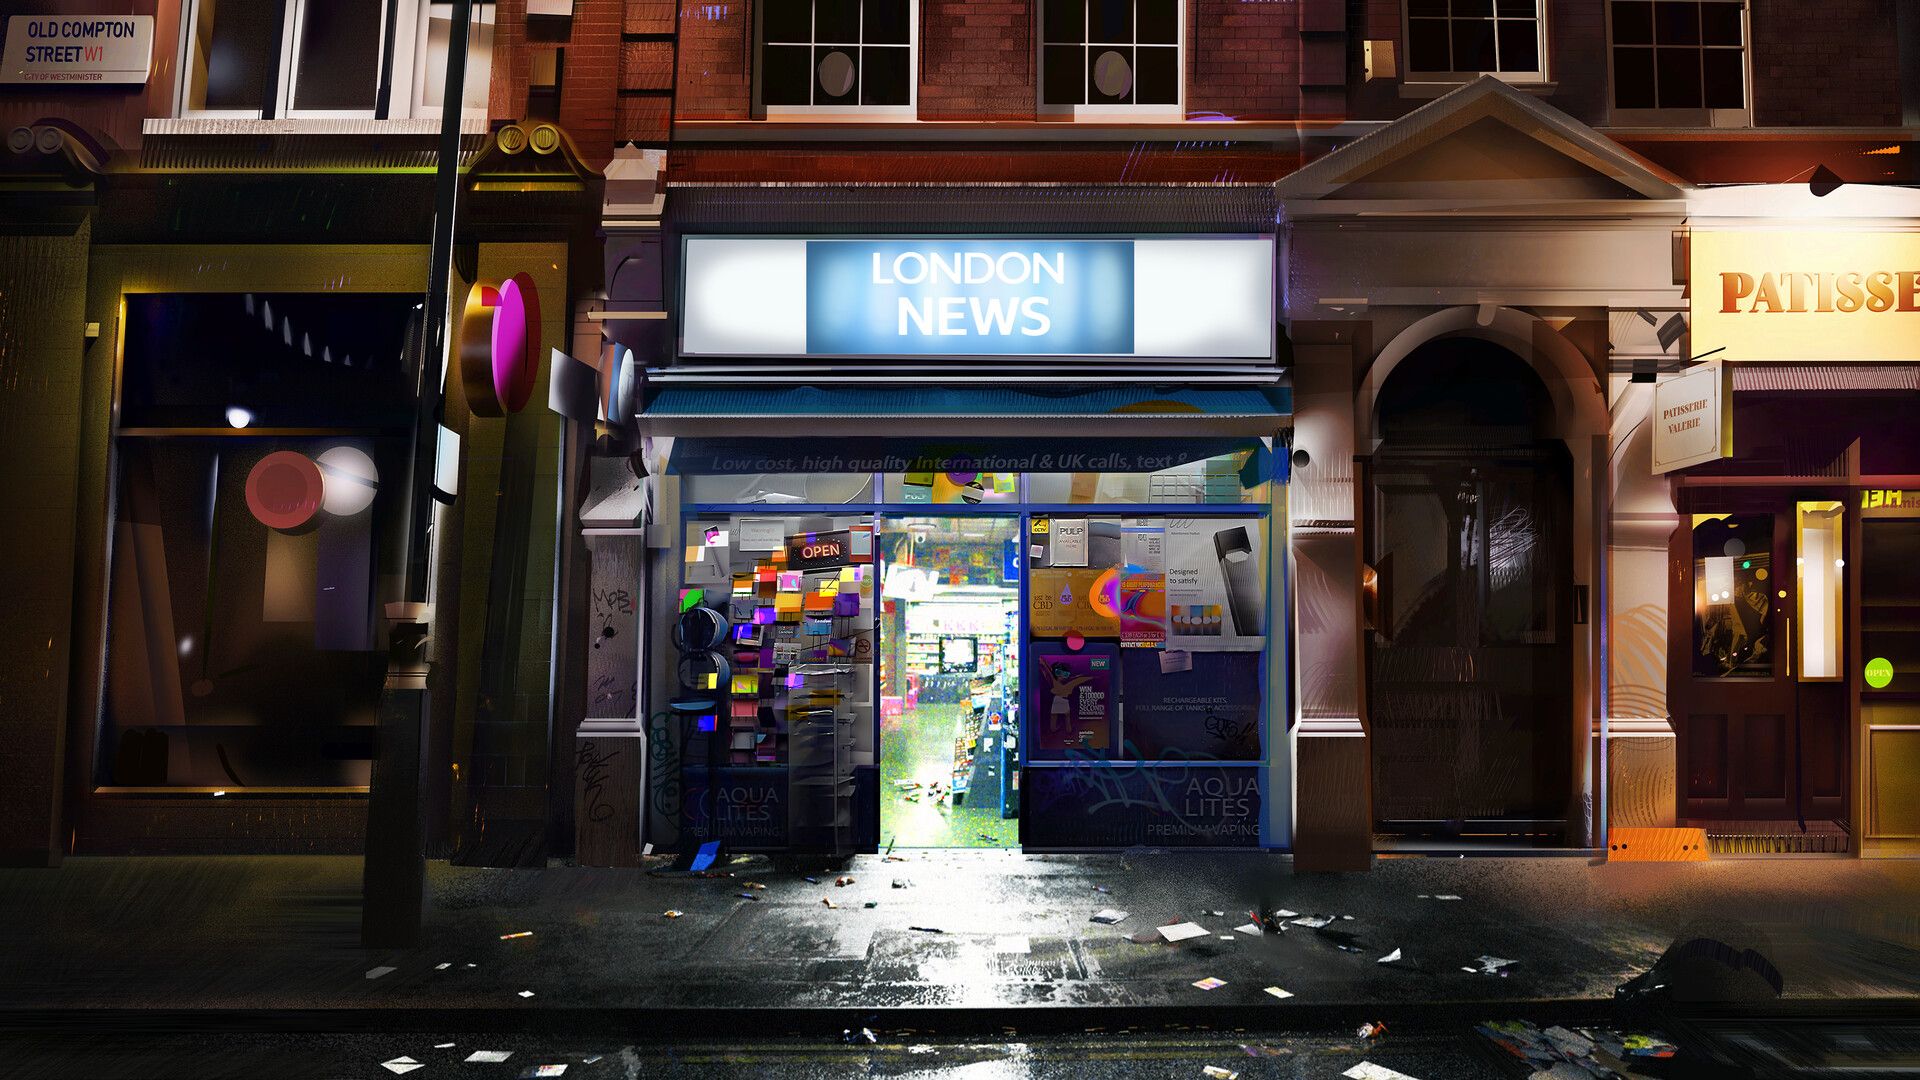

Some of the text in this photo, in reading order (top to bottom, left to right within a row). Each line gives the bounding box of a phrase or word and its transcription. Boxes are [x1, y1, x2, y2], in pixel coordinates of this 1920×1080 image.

[28, 21, 135, 38] OLD COMPTON
[25, 45, 103, 63] STREET W1
[40, 73, 49, 81] OF
[872, 252, 1065, 285] LONDON
[1719, 270, 1920, 313] PATISSE
[898, 296, 1051, 336] NEWS
[1663, 399, 1708, 420] PATISSERIE
[1668, 417, 1701, 434] VALERIE
[712, 456, 751, 471] Low
[755, 457, 799, 472] cost,
[802, 455, 843, 473] high
[848, 455, 911, 473] quality
[915, 453, 1037, 470] International
[1039, 454, 1053, 469] &
[1058, 453, 1086, 469] UK
[1088, 452, 1132, 470] calls,
[1137, 455, 1173, 468] text
[1059, 527, 1084, 535] PULP
[802, 544, 840, 559] OPEN
[1169, 568, 1199, 576] Designed
[1178, 577, 1198, 585] satisfy
[1033, 601, 1053, 610] CBD
[1866, 669, 1891, 677] OPEN
[1151, 704, 1174, 712] RANGE
[717, 787, 779, 804] AQUA
[1185, 777, 1260, 798] AQUA
[717, 804, 770, 821] LITES
[1185, 798, 1250, 817] LITES
